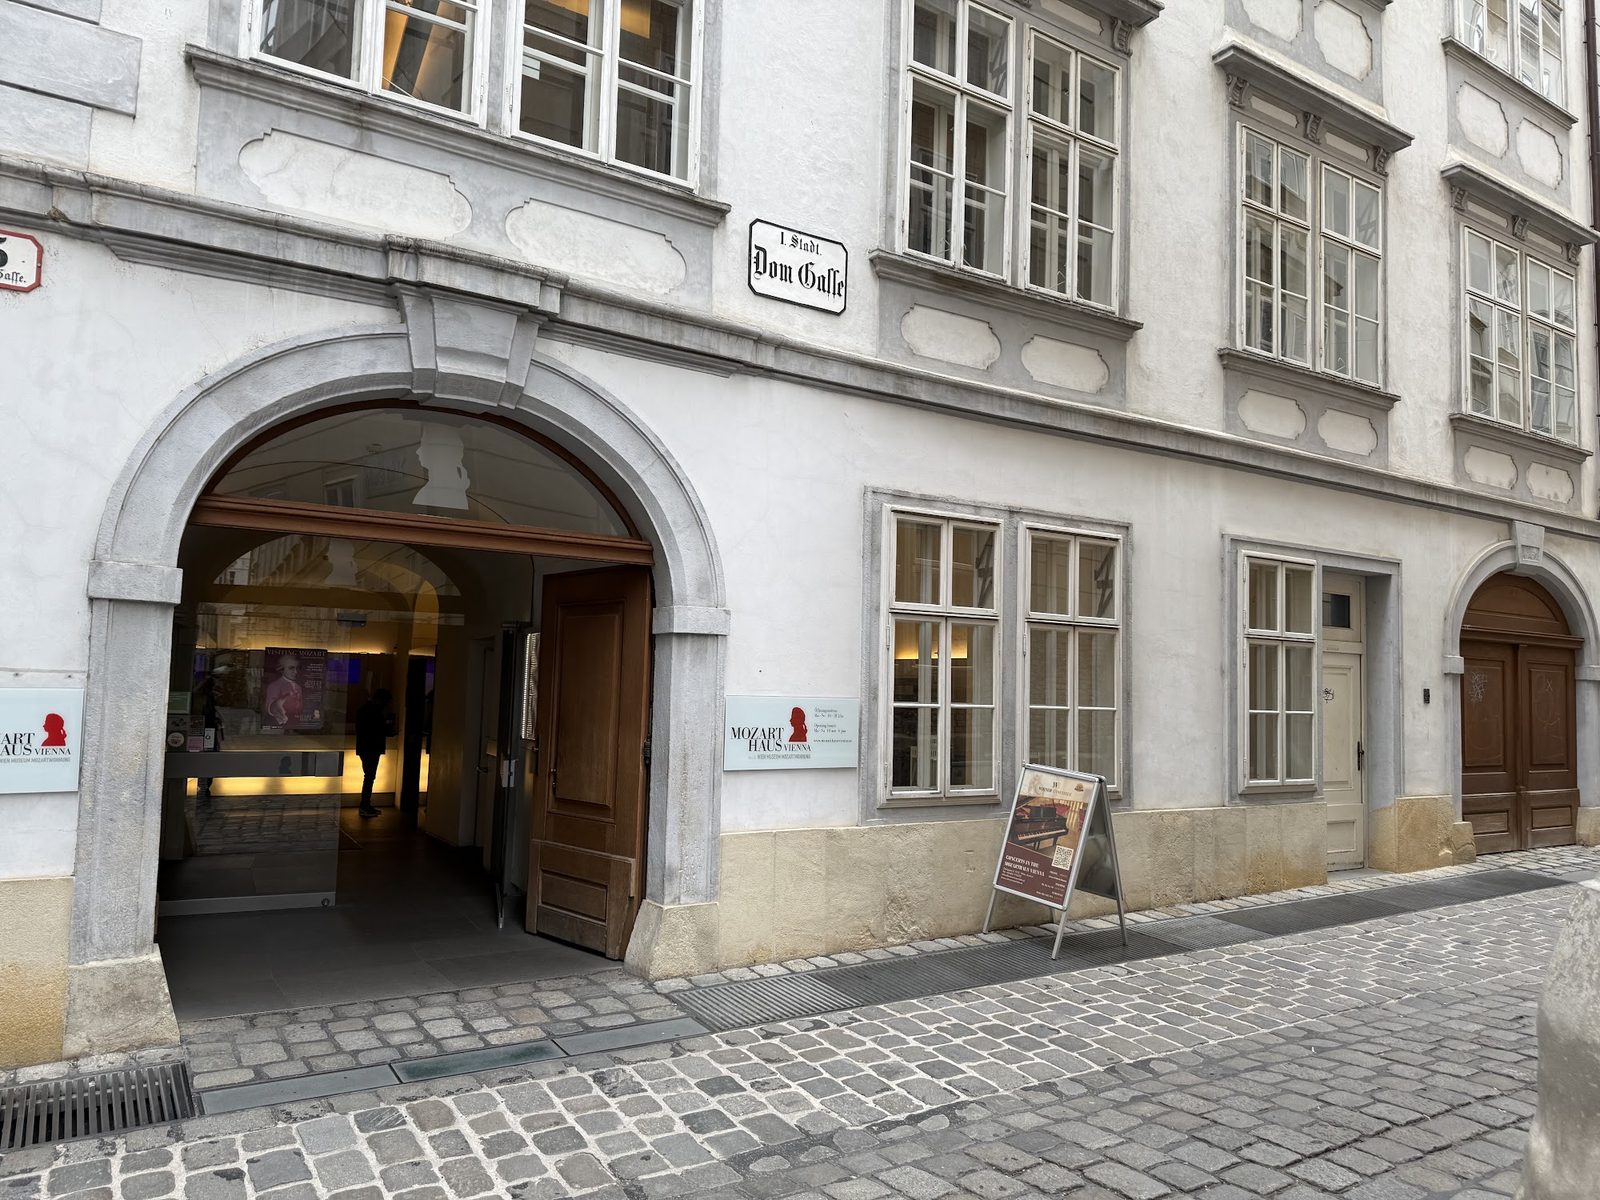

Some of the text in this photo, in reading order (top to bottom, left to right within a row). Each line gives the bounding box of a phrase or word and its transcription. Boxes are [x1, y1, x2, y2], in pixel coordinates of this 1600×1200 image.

[753, 244, 844, 299] Dom Gasse
[731, 726, 785, 740] MOZART
[748, 740, 812, 752] HAUS VIENNA
